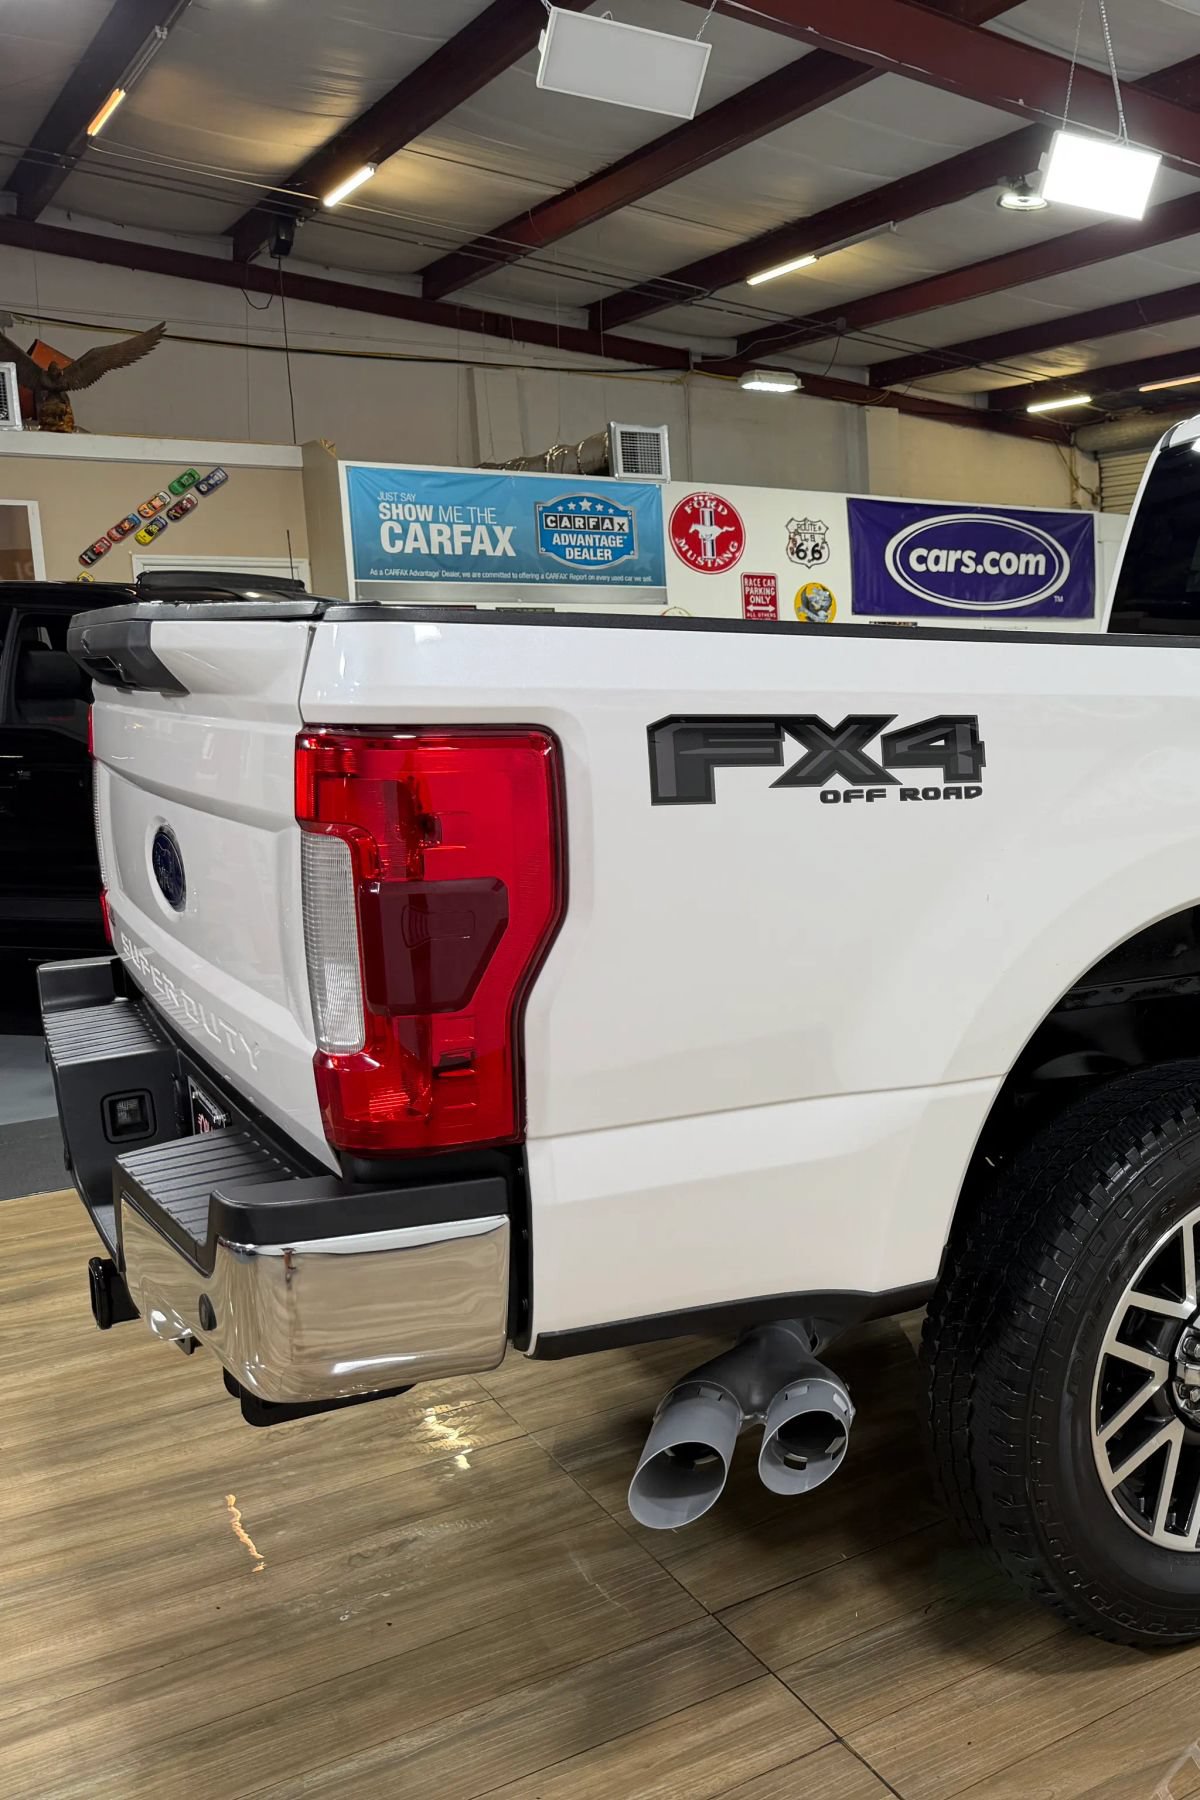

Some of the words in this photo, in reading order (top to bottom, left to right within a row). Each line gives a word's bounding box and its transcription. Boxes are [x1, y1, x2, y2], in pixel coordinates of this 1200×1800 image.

[377, 491, 398, 501] JUST
[400, 492, 416, 502] SAY
[378, 502, 433, 521] SHOW
[438, 505, 464, 523] ME
[466, 506, 497, 524] THE
[684, 500, 728, 515] FORD
[545, 514, 628, 532] CARFAX
[380, 520, 517, 557] CARFAX
[552, 533, 624, 548] ADVANTAGE
[565, 547, 613, 561] DEALER
[674, 537, 739, 568] MUSTANG
[796, 542, 823, 560] 66
[909, 545, 1046, 577] cars.com
[369, 568, 378, 576] As
[384, 568, 408, 577] CARFAX
[511, 571, 518, 579] to
[518, 572, 540, 581] offering
[569, 573, 588, 581] Report
[744, 578, 761, 587] RACE
[762, 578, 776, 587] CAR
[745, 586, 776, 596] PARKING
[750, 595, 771, 604] ONLY
[646, 713, 986, 806] FX4
[819, 788, 887, 804] OFF
[900, 786, 983, 802] ROAD
